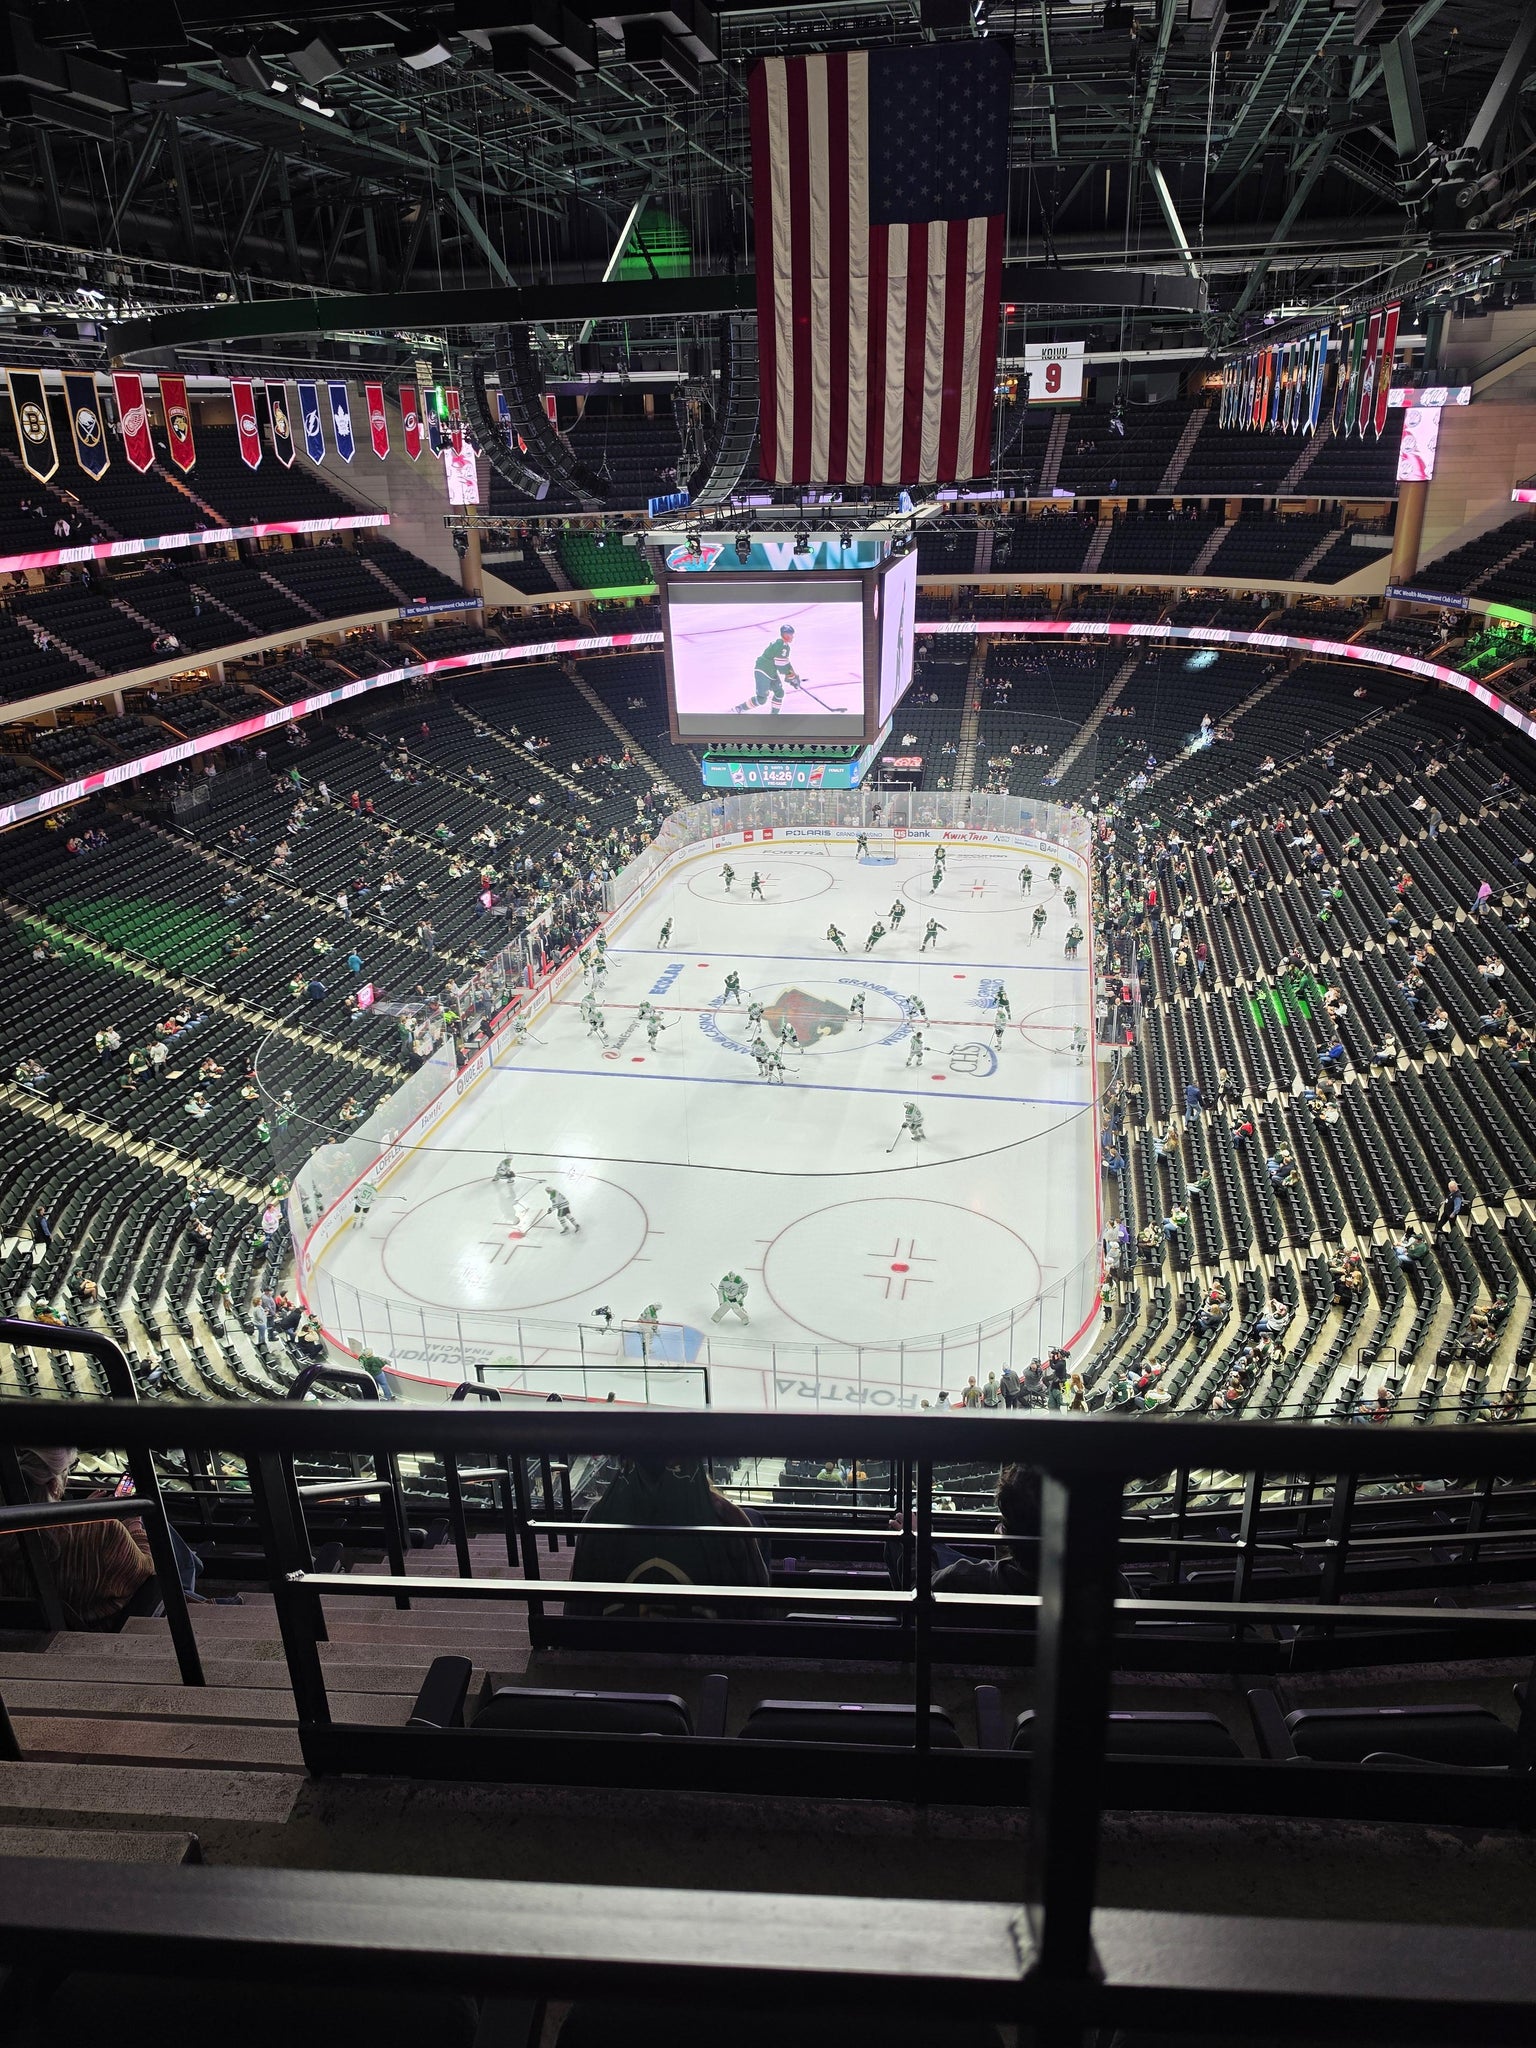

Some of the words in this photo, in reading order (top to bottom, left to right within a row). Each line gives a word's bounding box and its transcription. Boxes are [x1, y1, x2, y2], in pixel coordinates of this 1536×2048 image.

[1042, 347, 1068, 360] KOIVU
[1045, 363, 1062, 393] 9
[1416, 592, 1442, 601] Management
[430, 603, 455, 611] Management
[748, 771, 757, 782] 0
[762, 770, 792, 781] 14:26
[797, 771, 806, 783] 0
[785, 829, 832, 837] POLARIS
[907, 829, 931, 838] bank
[648, 963, 685, 995] ECOLAB
[838, 977, 888, 992] GRAND
[698, 1013, 719, 1038] CASINO
[950, 1044, 982, 1073] CHS
[361, 1189, 372, 1200] 57
[426, 1343, 495, 1356] FINANCIAL
[775, 1378, 918, 1410] FORTRA
